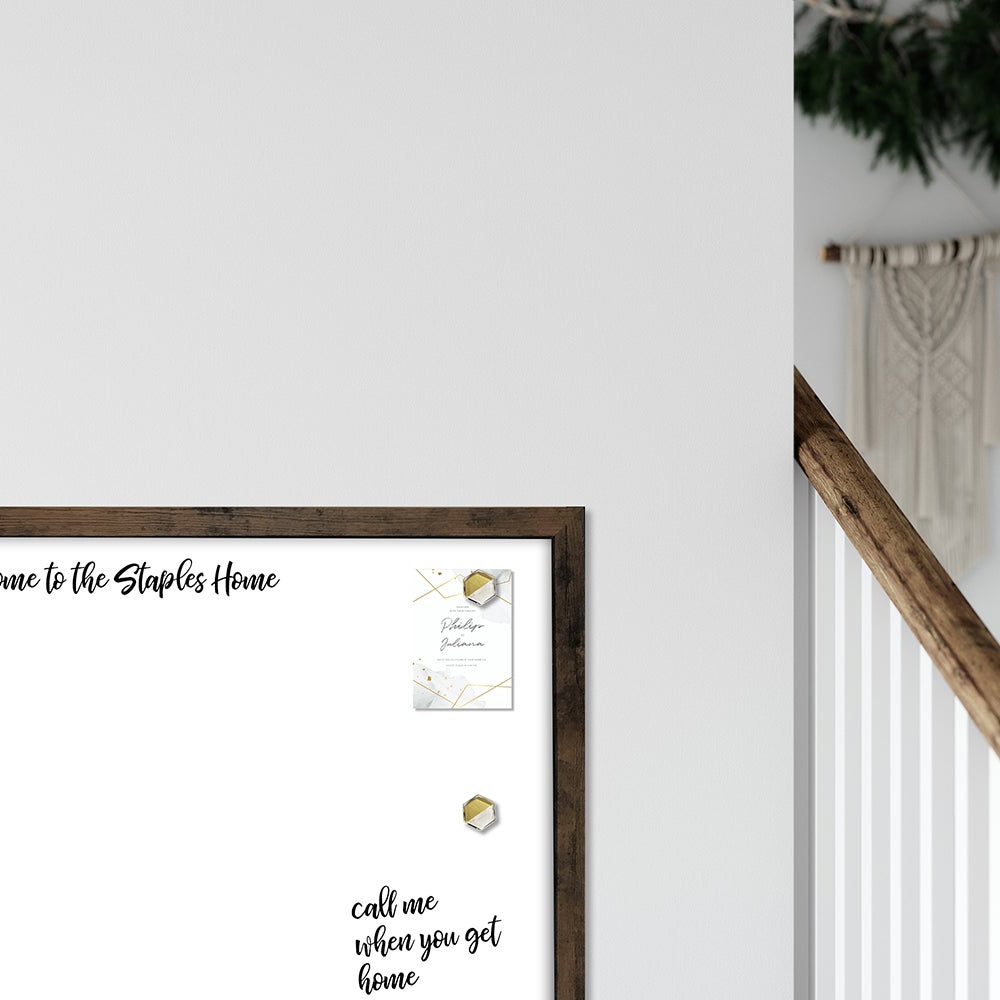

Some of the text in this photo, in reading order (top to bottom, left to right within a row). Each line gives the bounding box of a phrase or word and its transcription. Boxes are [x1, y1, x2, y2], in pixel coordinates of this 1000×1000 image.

[44, 562, 66, 594] to
[71, 561, 109, 594] the
[114, 558, 207, 598] Staples
[211, 561, 280, 596] Home
[352, 886, 438, 919] call me
[356, 915, 501, 962] when you get
[359, 963, 419, 995] home
